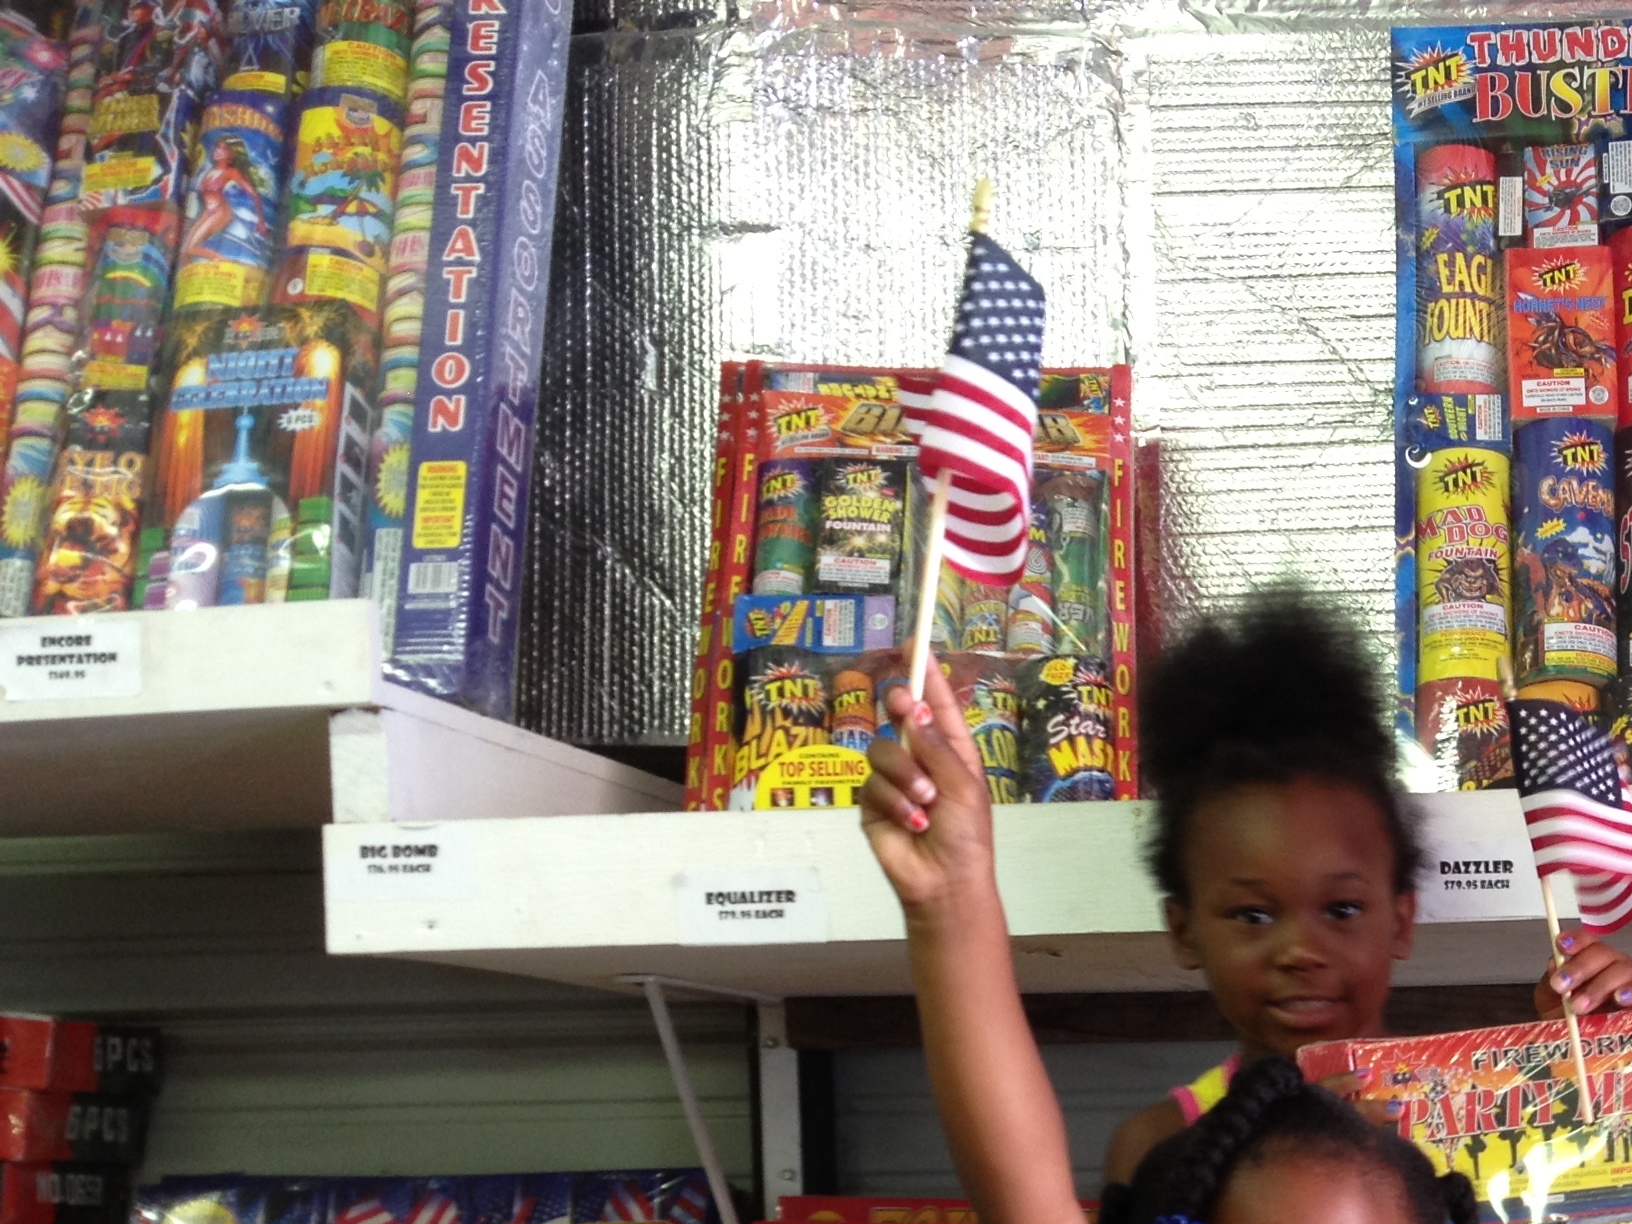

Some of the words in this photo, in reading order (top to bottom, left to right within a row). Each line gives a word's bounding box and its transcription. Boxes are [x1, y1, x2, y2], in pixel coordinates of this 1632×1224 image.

[1410, 56, 1463, 96] TNT
[1550, 158, 1581, 169] SUN
[1445, 184, 1495, 214] TNT
[427, 0, 507, 432] ESENTATION
[1542, 263, 1577, 288] TNT
[776, 407, 823, 436] TNT
[1562, 443, 1600, 467] TNT
[846, 469, 879, 486] TNT
[1444, 467, 1483, 489] TNT
[824, 496, 896, 512] GOLDEN
[829, 505, 892, 523] SHOWER
[825, 521, 891, 532] FOUNTAIN
[1417, 504, 1487, 543] MAD
[1445, 520, 1509, 546] DOG
[1427, 545, 1499, 562] FOUNTAIN
[1441, 602, 1484, 611] CAUTION
[40, 634, 93, 648] ENCORE
[15, 652, 118, 667] PRESENTATION
[765, 678, 820, 709] TNT
[1456, 700, 1496, 728] TNT
[1047, 714, 1107, 744] Star
[778, 762, 805, 777] TOP
[809, 760, 865, 777] SELLING
[359, 845, 388, 859] BIG
[392, 844, 438, 858] BOMB
[1440, 860, 1514, 875] DAZZLER
[1444, 880, 1478, 890] $79.95
[1480, 879, 1510, 889] EACH
[705, 890, 796, 906] EQUALIZER
[1398, 1077, 1567, 1141] PARTY
